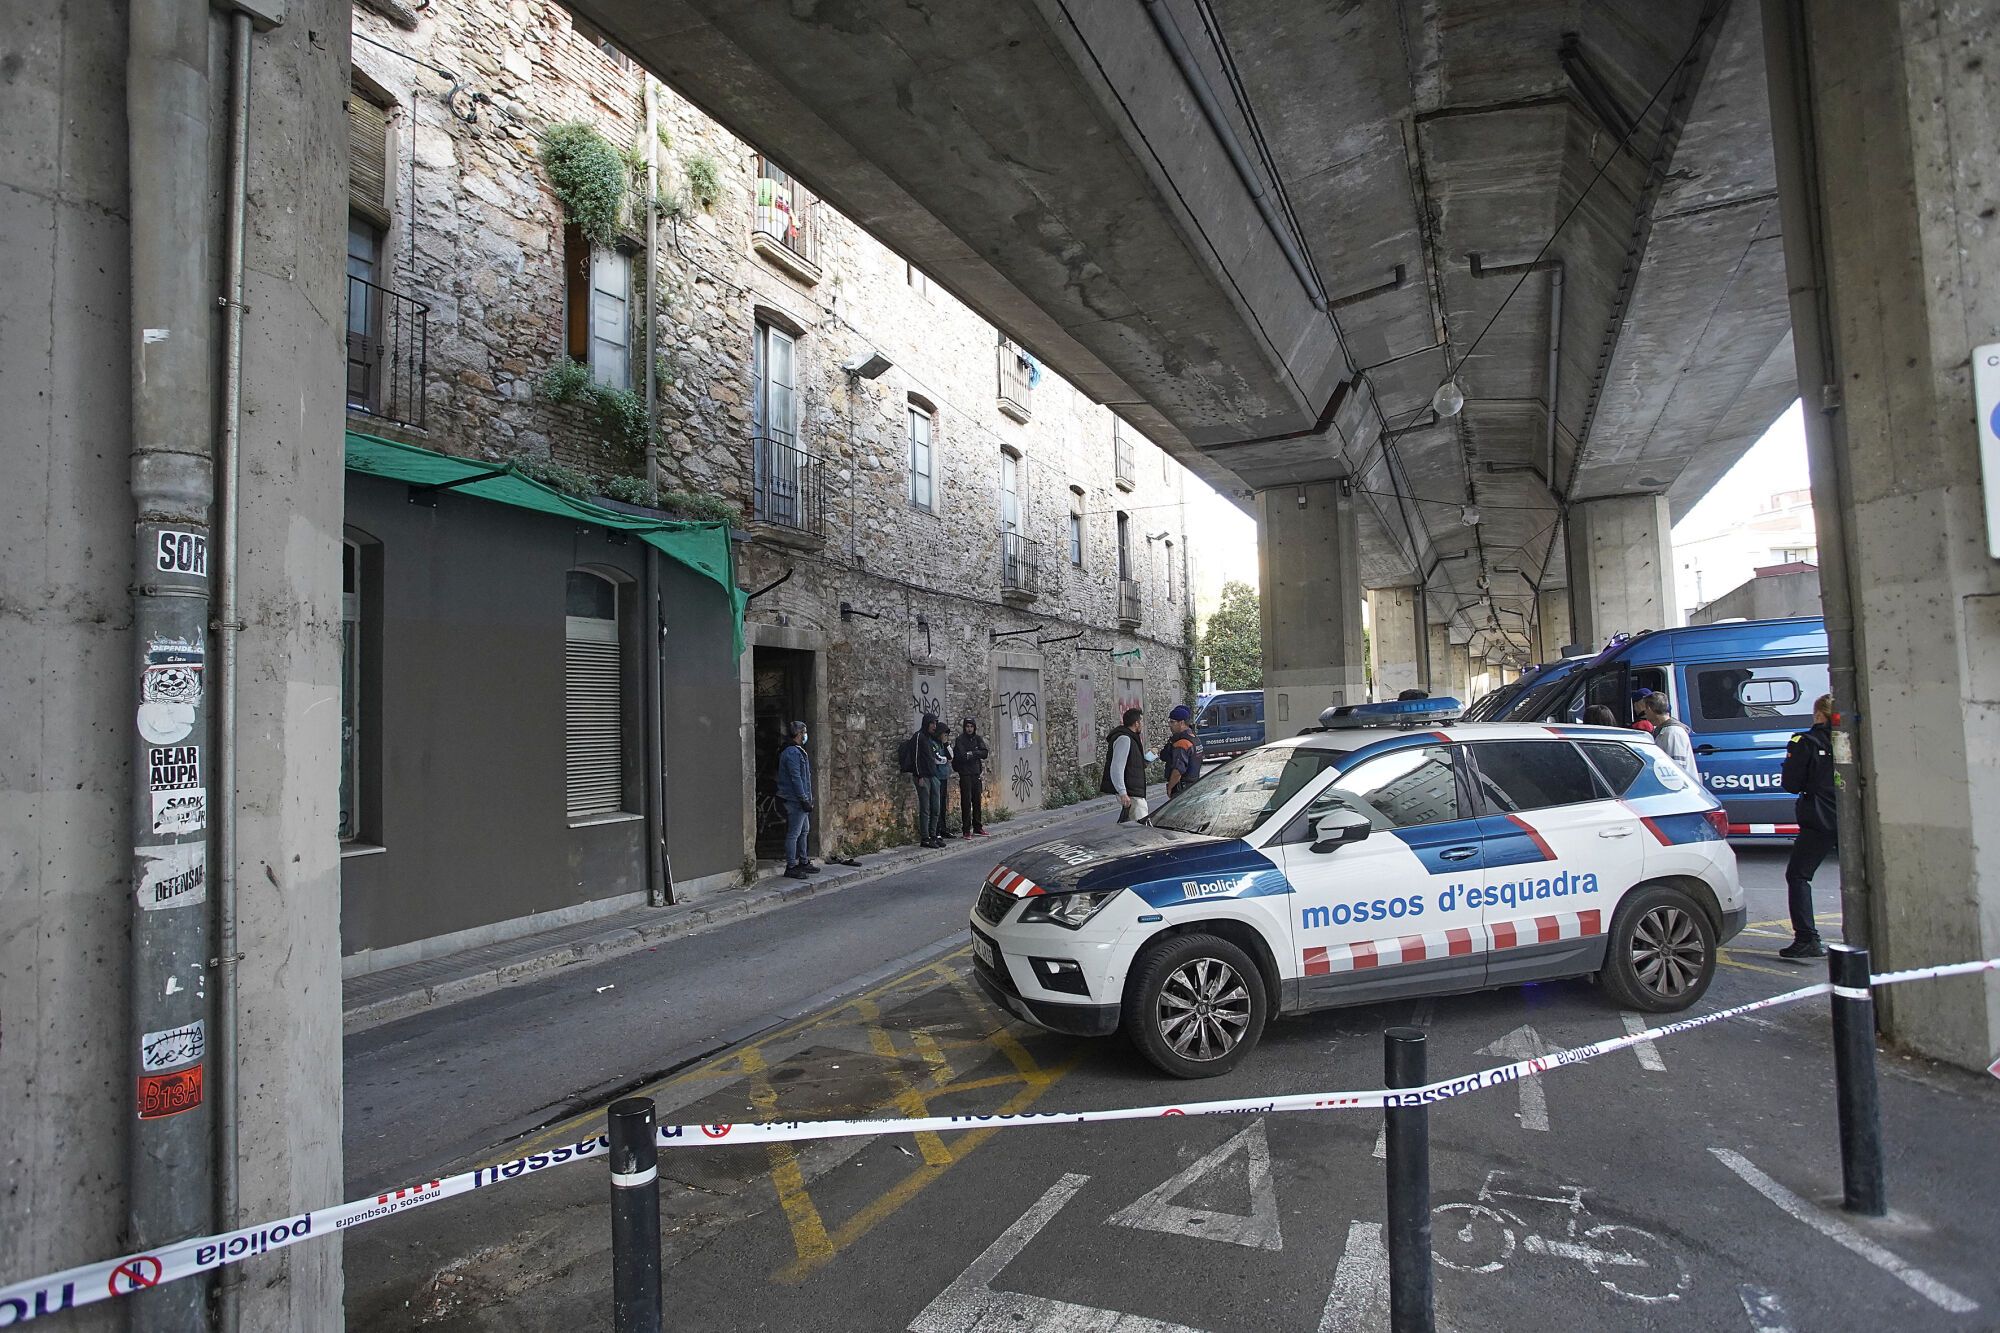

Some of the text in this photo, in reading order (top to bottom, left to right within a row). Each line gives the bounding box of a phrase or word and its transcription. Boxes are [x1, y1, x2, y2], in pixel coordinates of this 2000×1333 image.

[150, 746, 198, 767] GEAR
[150, 764, 198, 785] AUPA
[1698, 771, 1782, 791] 'esqua
[1303, 870, 1598, 930] mossos d'esquadra
[335, 1189, 441, 1229] mossos d'esquadra
[196, 1212, 312, 1267] policia
